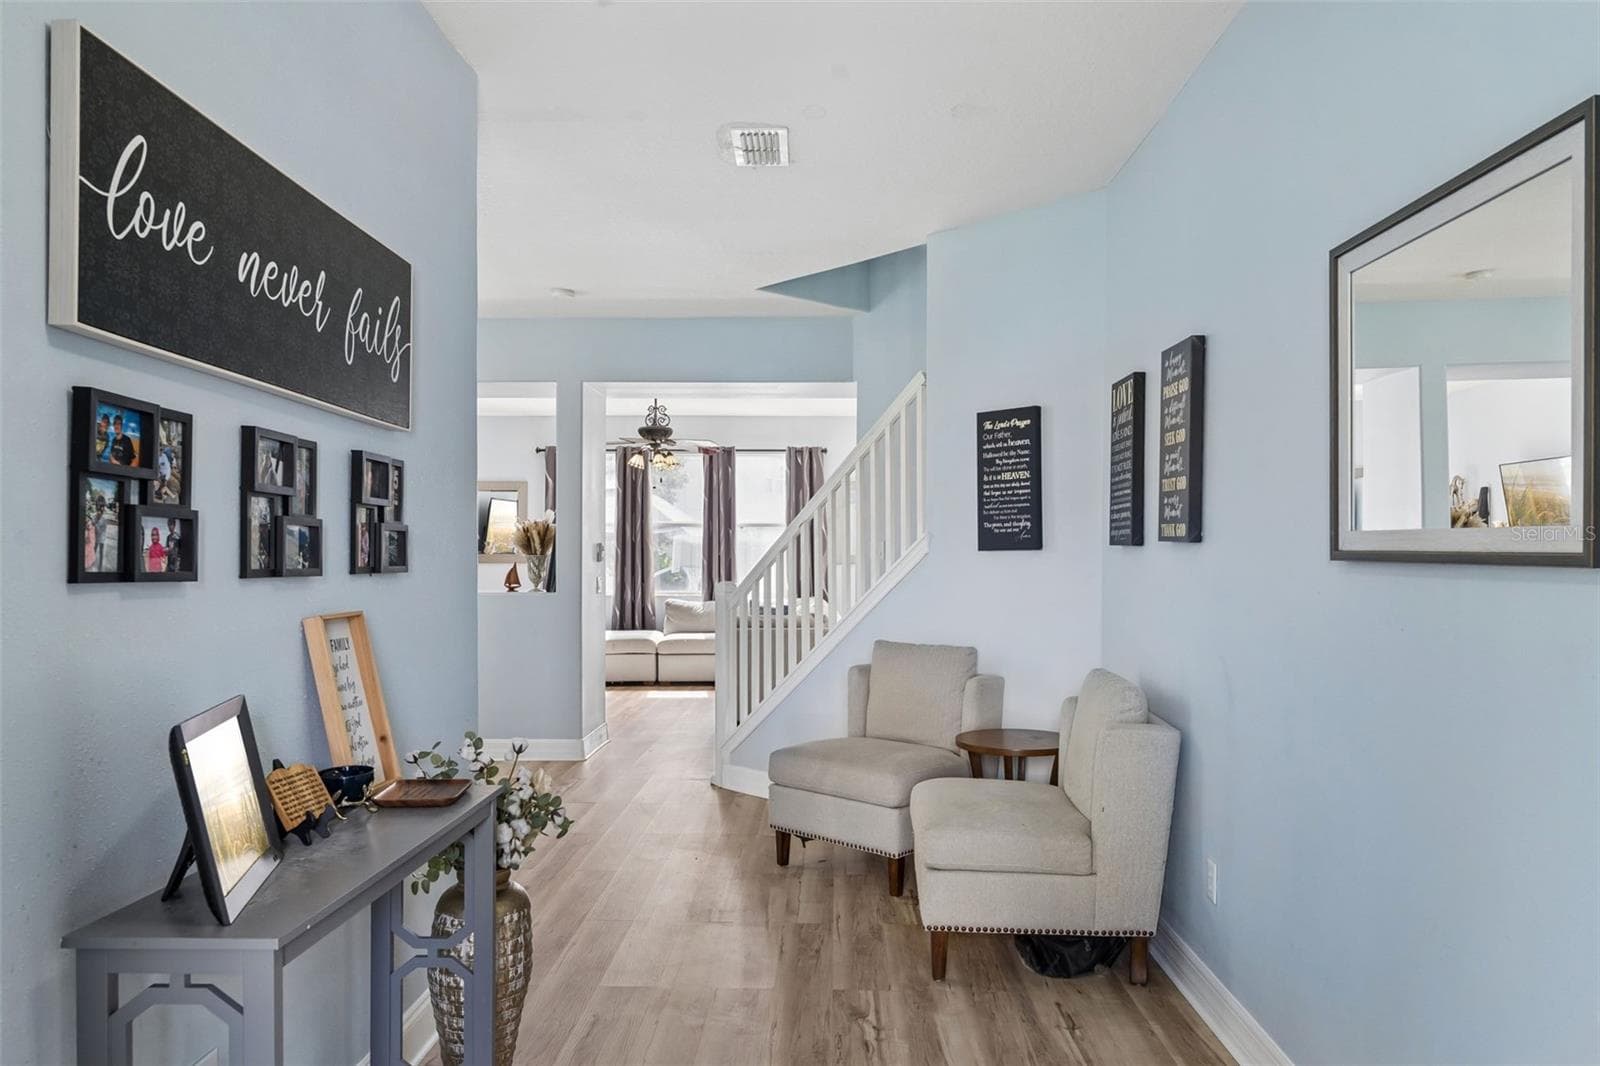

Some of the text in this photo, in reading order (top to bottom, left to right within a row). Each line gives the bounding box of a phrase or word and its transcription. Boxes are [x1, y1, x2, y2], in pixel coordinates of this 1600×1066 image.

[79, 134, 411, 383] love never fails
[1178, 377, 1190, 393] GOD
[1112, 379, 1134, 412] LOVE
[983, 420, 993, 430] The
[1010, 418, 1031, 429] Prayer
[1164, 428, 1186, 447] SEEK GOD
[1176, 475, 1186, 490] GOD
[1161, 523, 1186, 537] THANK GOD
[329, 636, 350, 653] FAMILY
